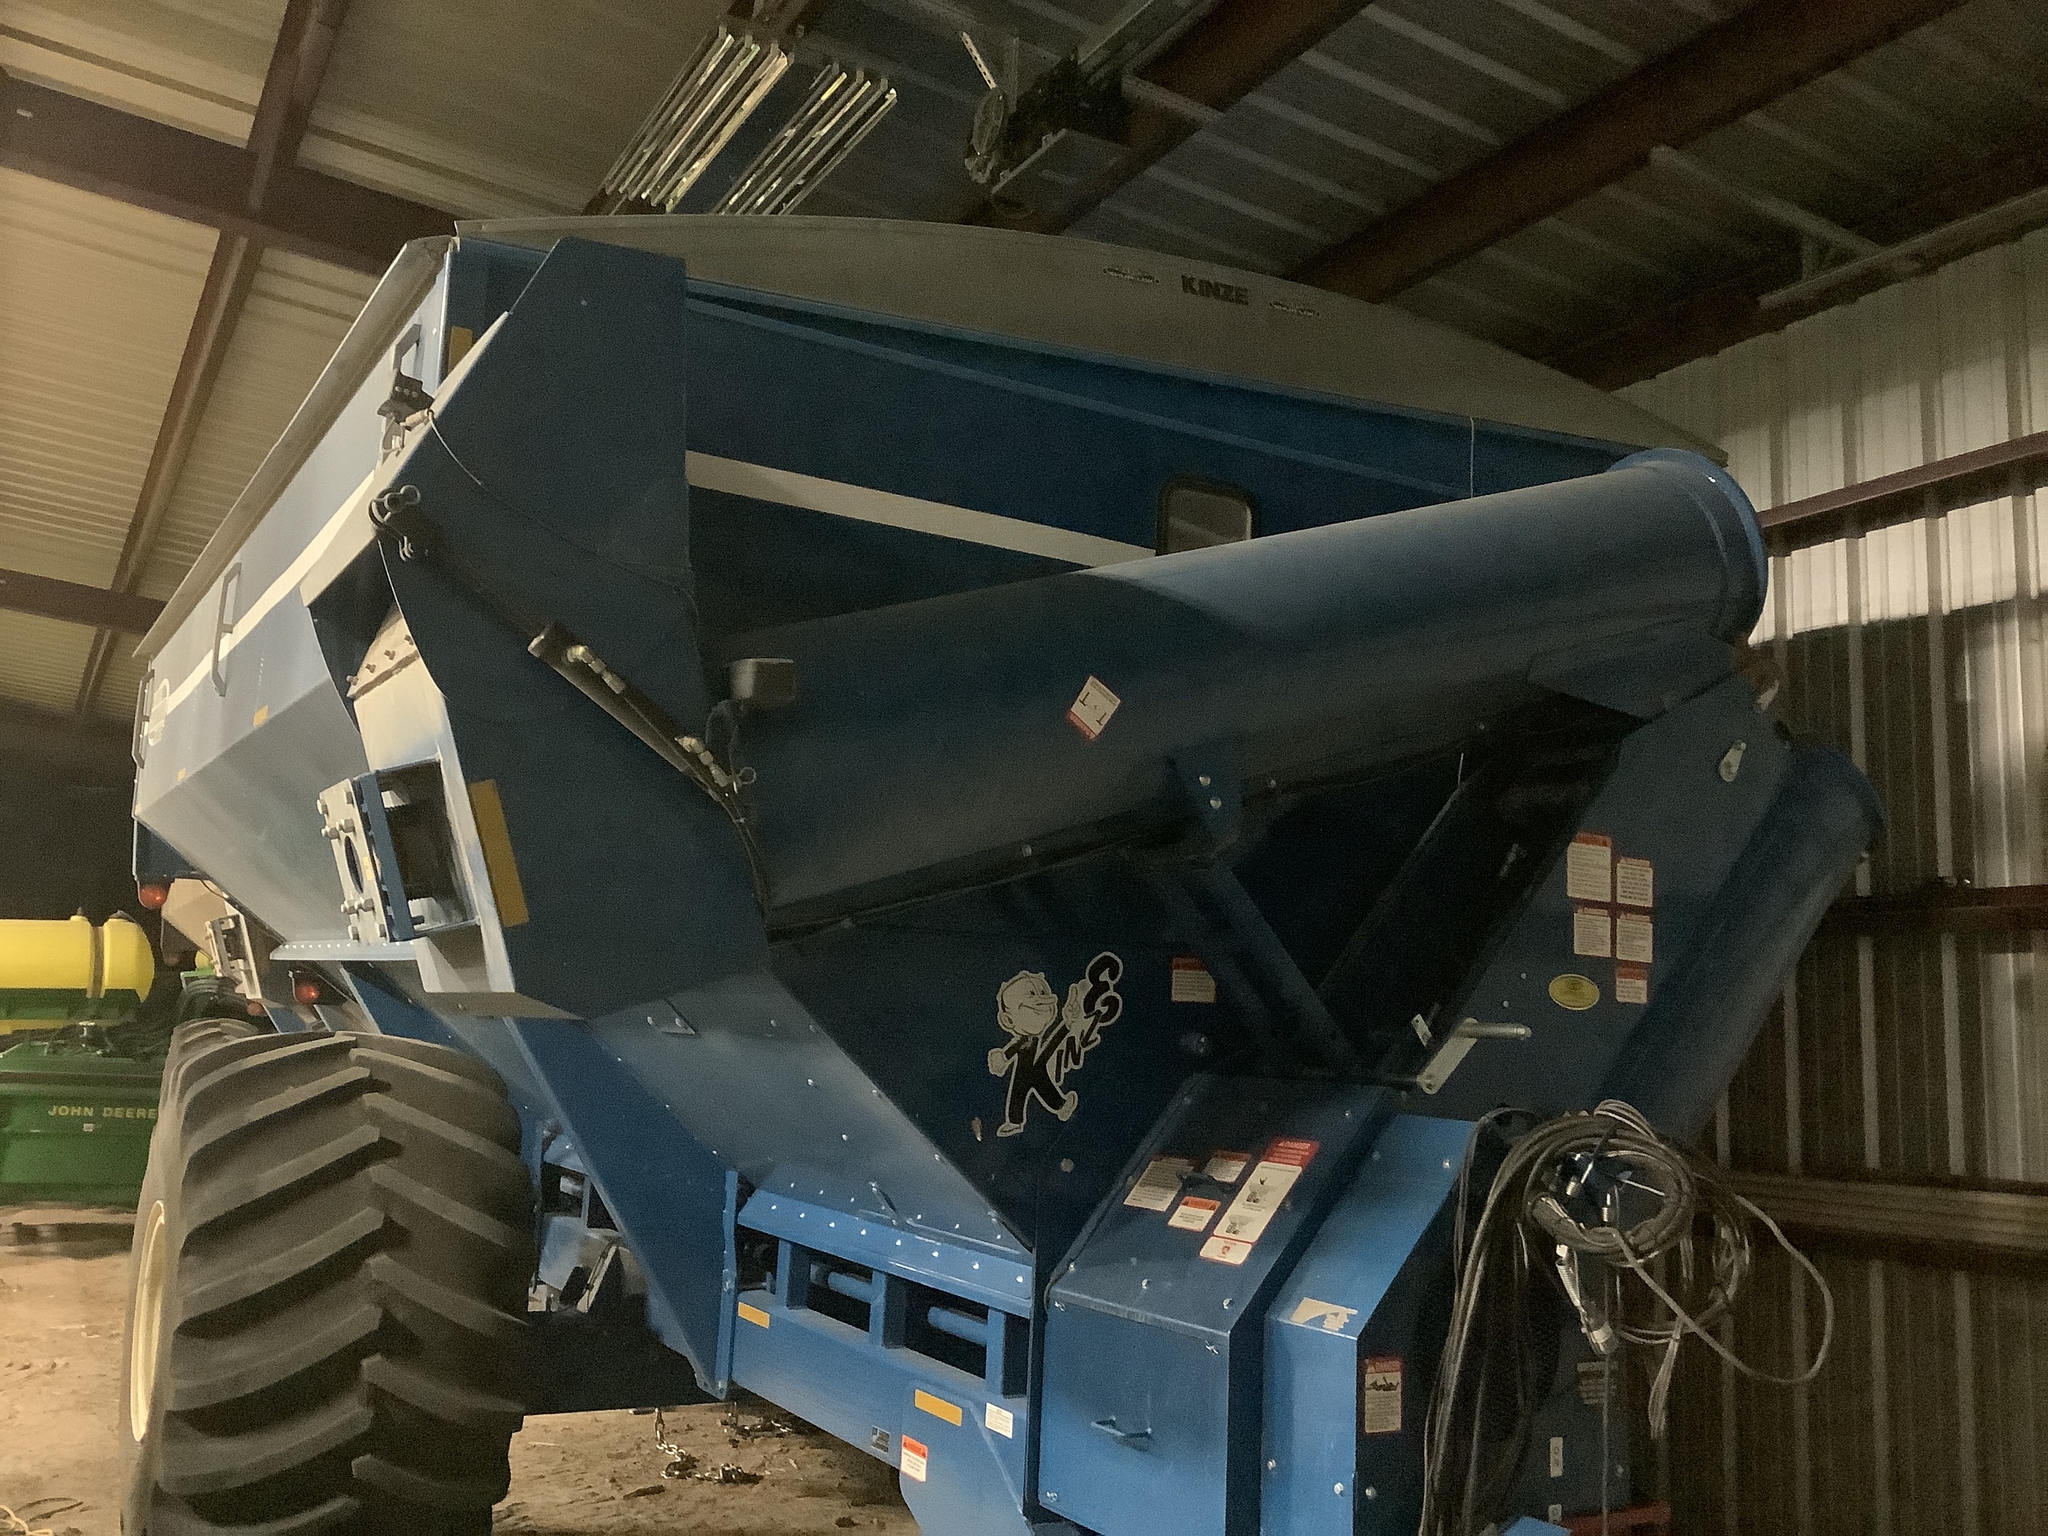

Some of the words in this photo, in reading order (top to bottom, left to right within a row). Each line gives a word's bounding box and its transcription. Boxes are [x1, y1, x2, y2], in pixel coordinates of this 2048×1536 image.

[1180, 274, 1250, 306] KINZE
[48, 1105, 94, 1117] JOHN
[102, 1107, 158, 1119] DEERE
